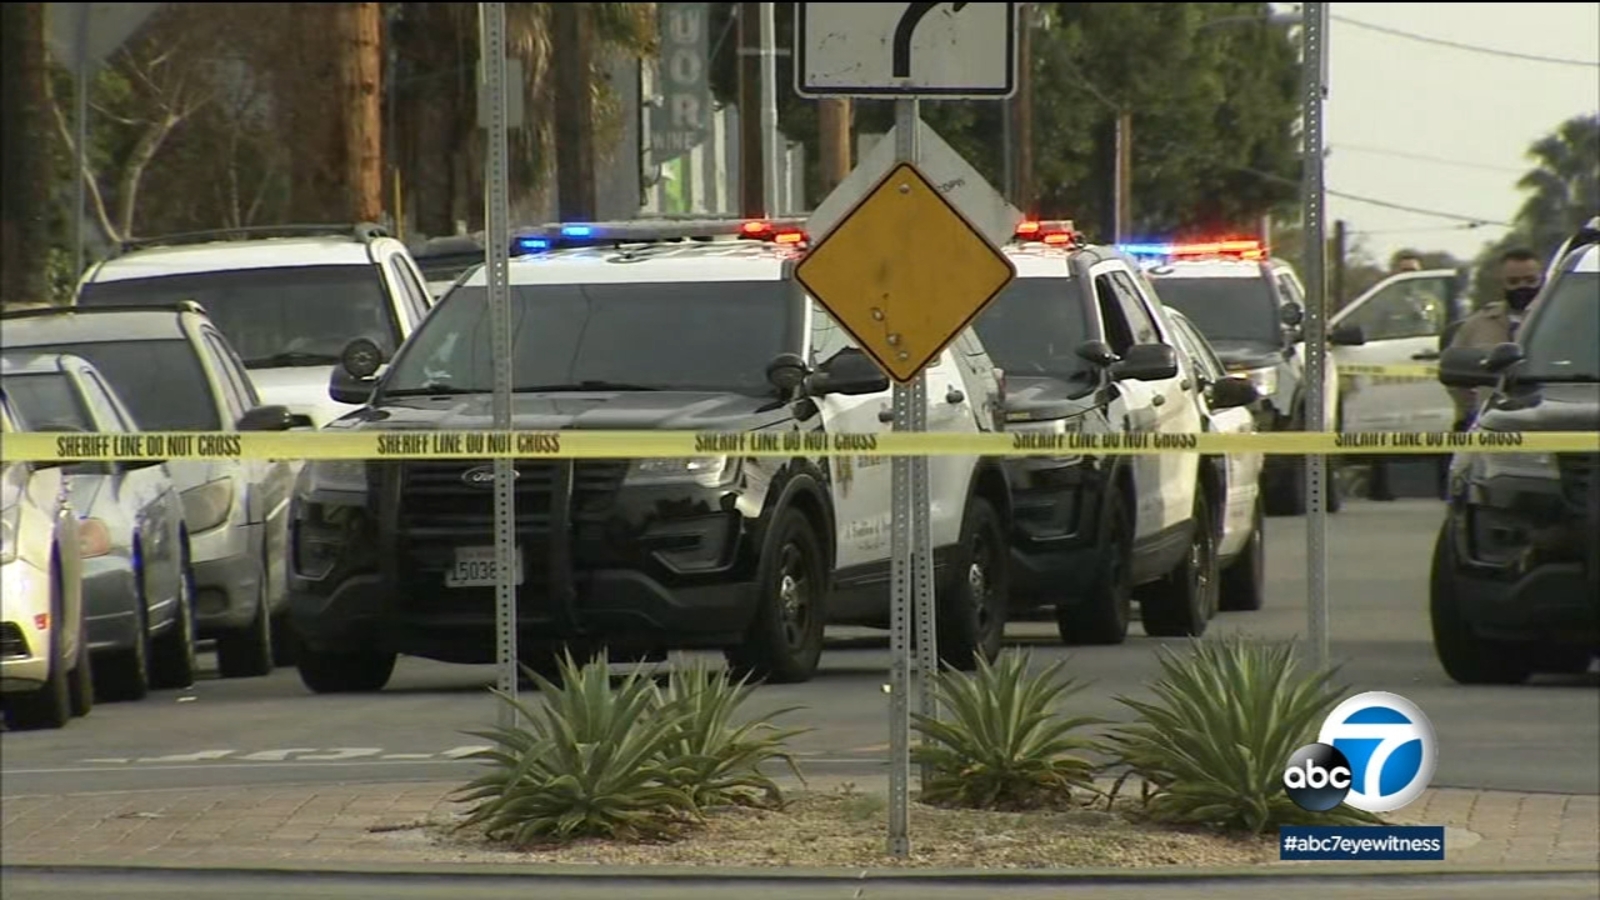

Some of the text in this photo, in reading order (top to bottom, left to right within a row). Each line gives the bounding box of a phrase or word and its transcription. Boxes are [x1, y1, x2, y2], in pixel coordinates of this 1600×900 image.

[56, 435, 241, 456] SHERIFF LINE DO NOT CROSS
[377, 433, 560, 454] SHERIFF LINE DO NOT CROSS
[695, 433, 877, 452] SHERIFF LINE DO NOT CROSS
[1013, 432, 1196, 449] SHERIFF LINE DO NOT CROSS
